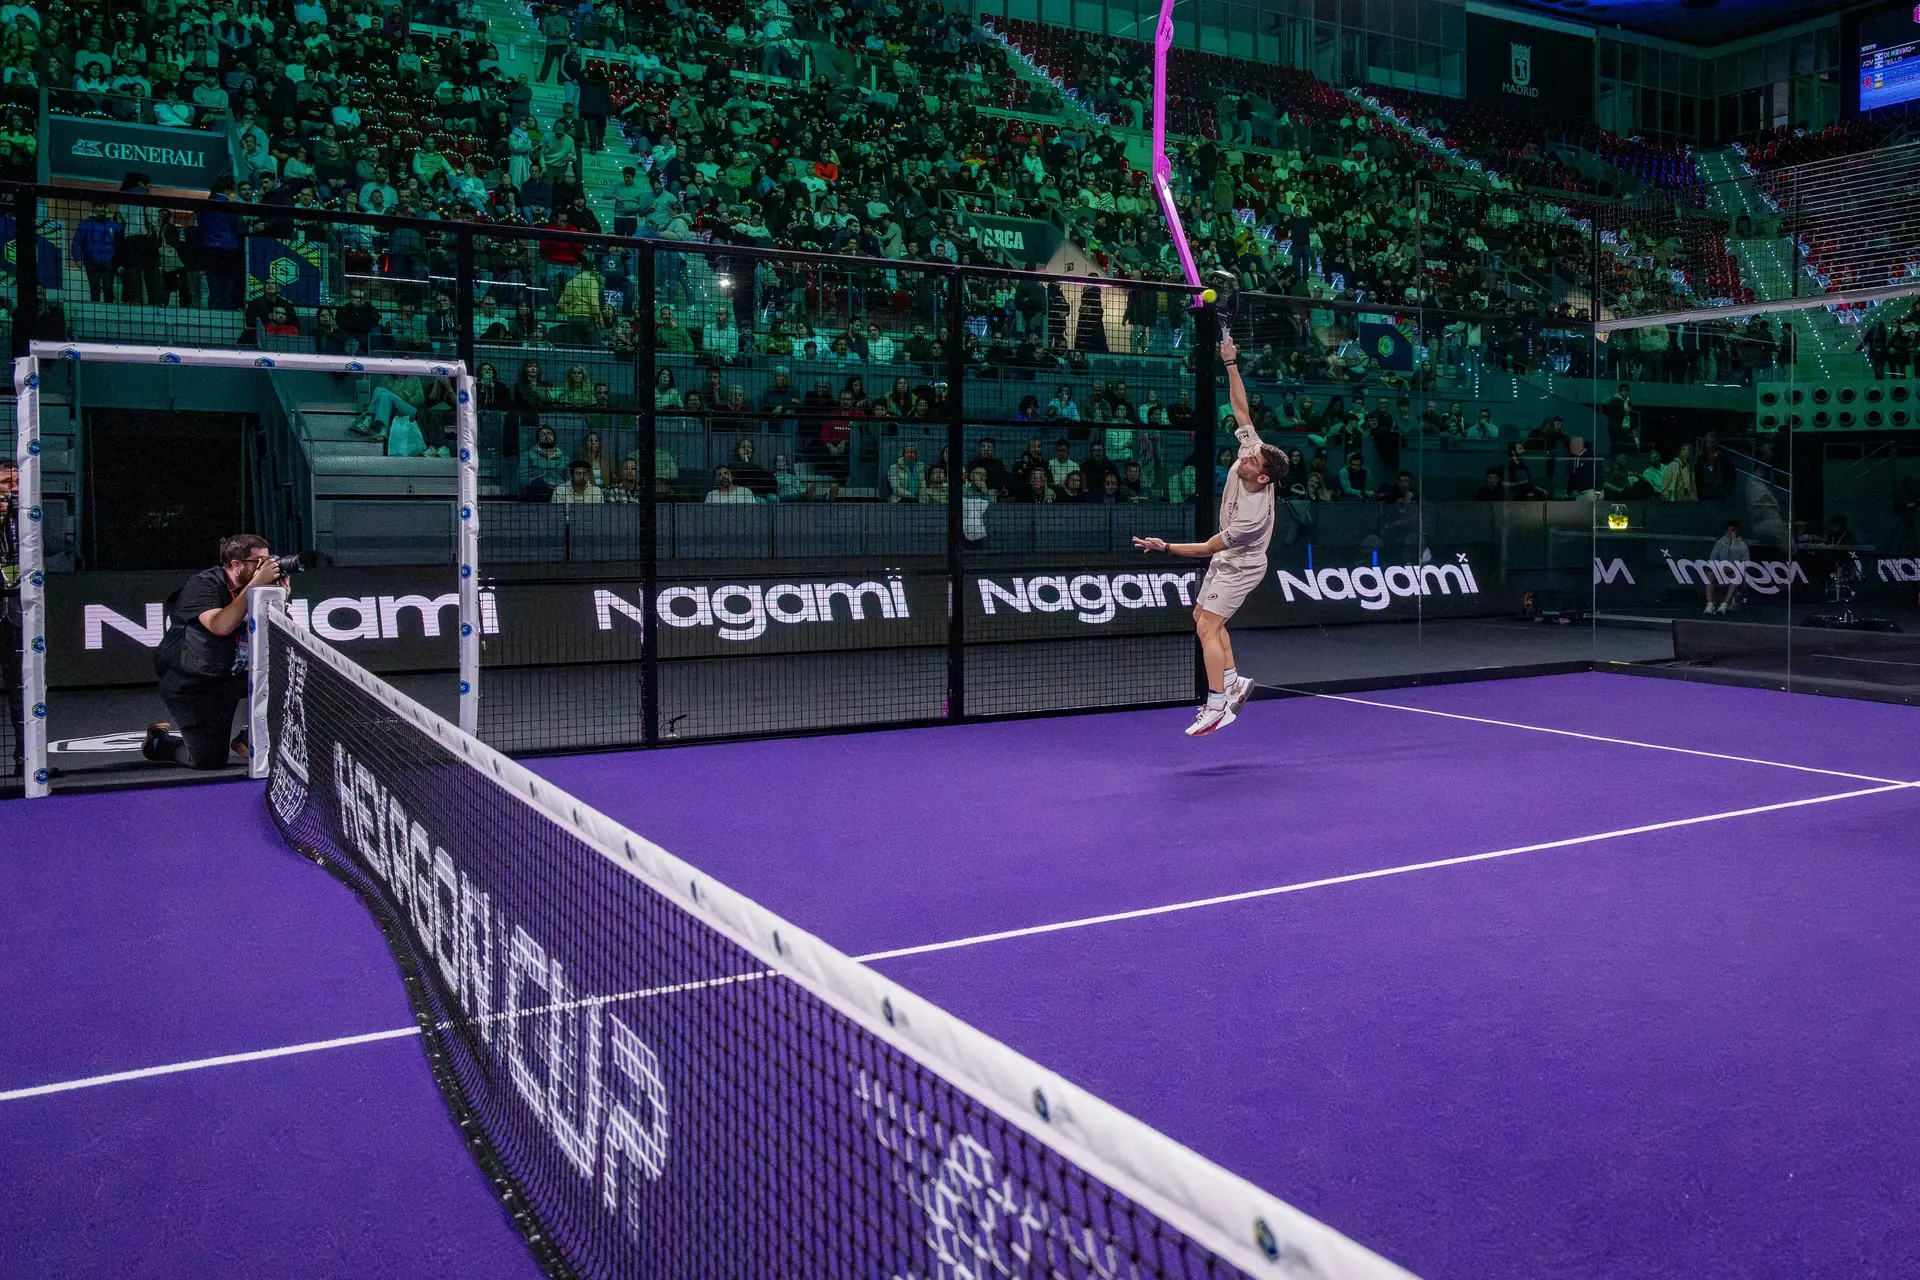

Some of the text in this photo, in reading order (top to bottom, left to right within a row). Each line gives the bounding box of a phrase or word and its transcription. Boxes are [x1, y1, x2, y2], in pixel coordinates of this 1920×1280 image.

[1502, 82, 1539, 98] MADRID
[104, 142, 205, 168] GENERALI
[968, 226, 1025, 250] ARCA
[593, 567, 911, 641] Nagami
[977, 571, 1196, 624] Nagam
[1276, 552, 1480, 610] Nagami
[84, 577, 500, 650] Nami
[333, 741, 670, 1240] HEXAGON CUP
